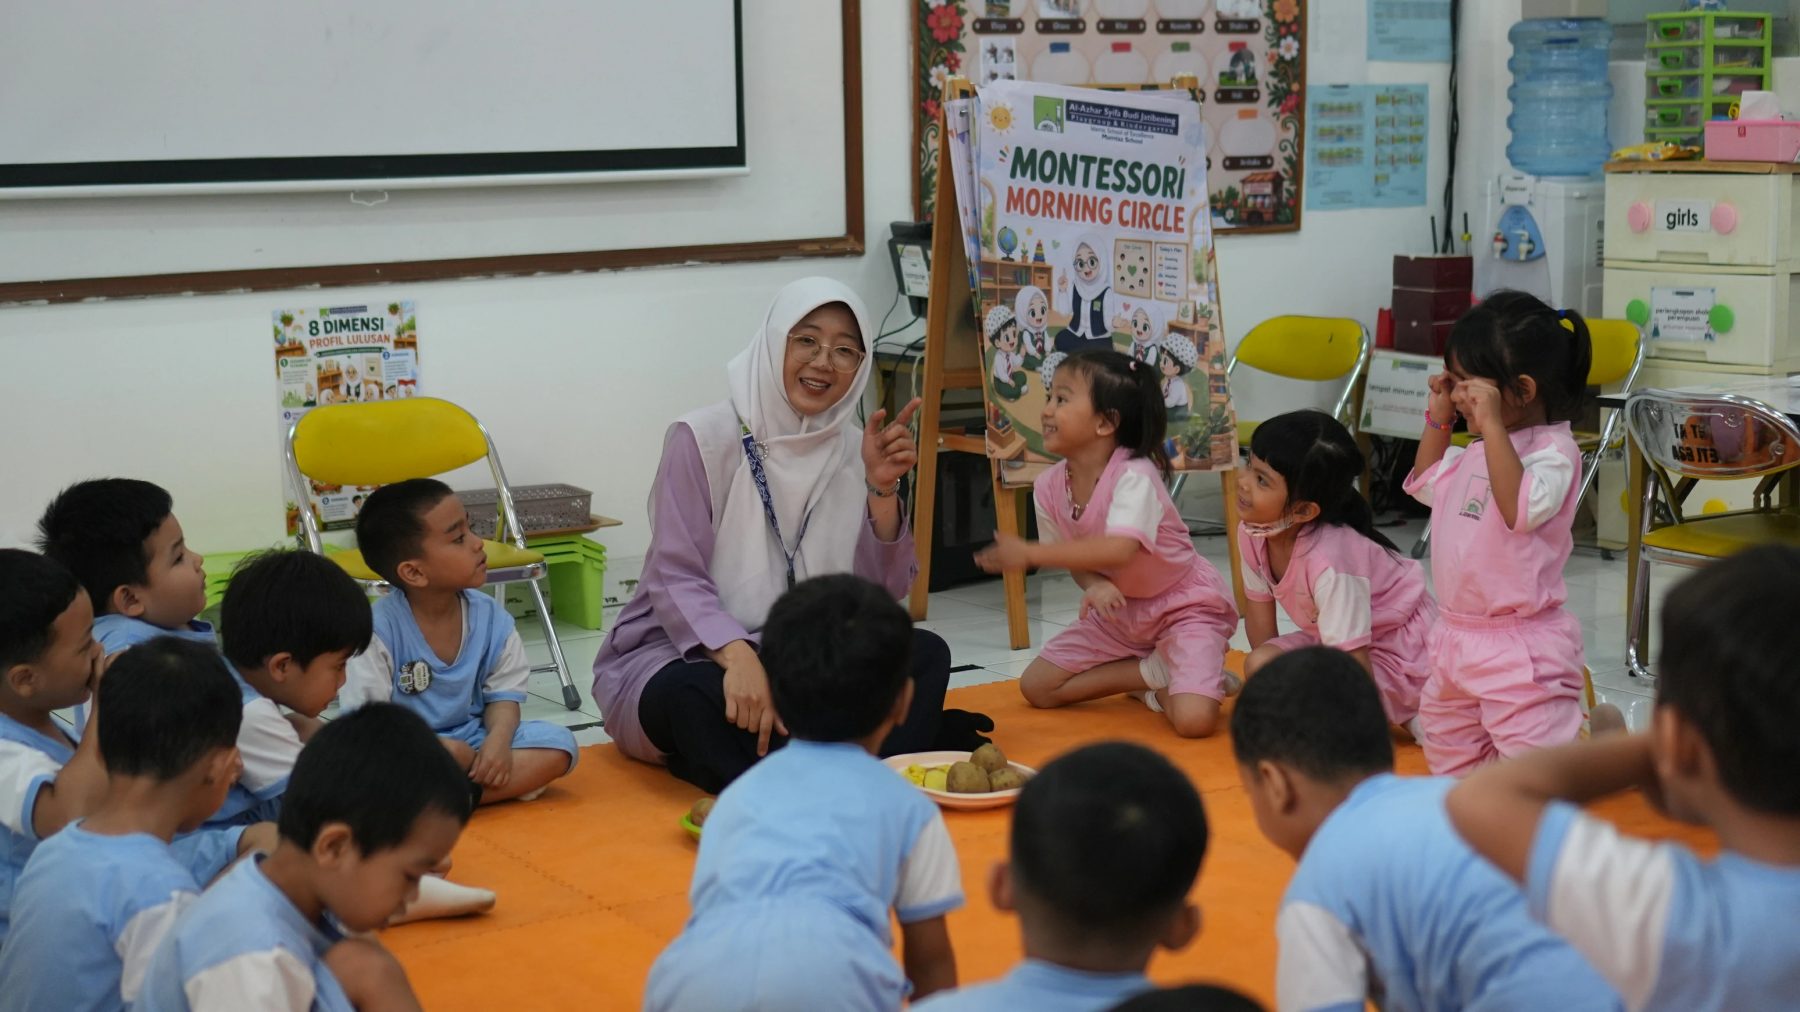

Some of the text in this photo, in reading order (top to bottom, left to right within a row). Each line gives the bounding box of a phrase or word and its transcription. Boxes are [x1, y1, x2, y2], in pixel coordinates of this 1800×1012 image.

[1069, 103, 1176, 127] Al-Azhar Syifa Budi Jatibening
[1009, 146, 1186, 200] MONTESSORI
[1006, 185, 1185, 234] MORNING CIRCLE
[1666, 208, 1699, 231] girls
[308, 317, 385, 337] 8 DIMENSI
[309, 333, 391, 349] PROFIL LULUSAN
